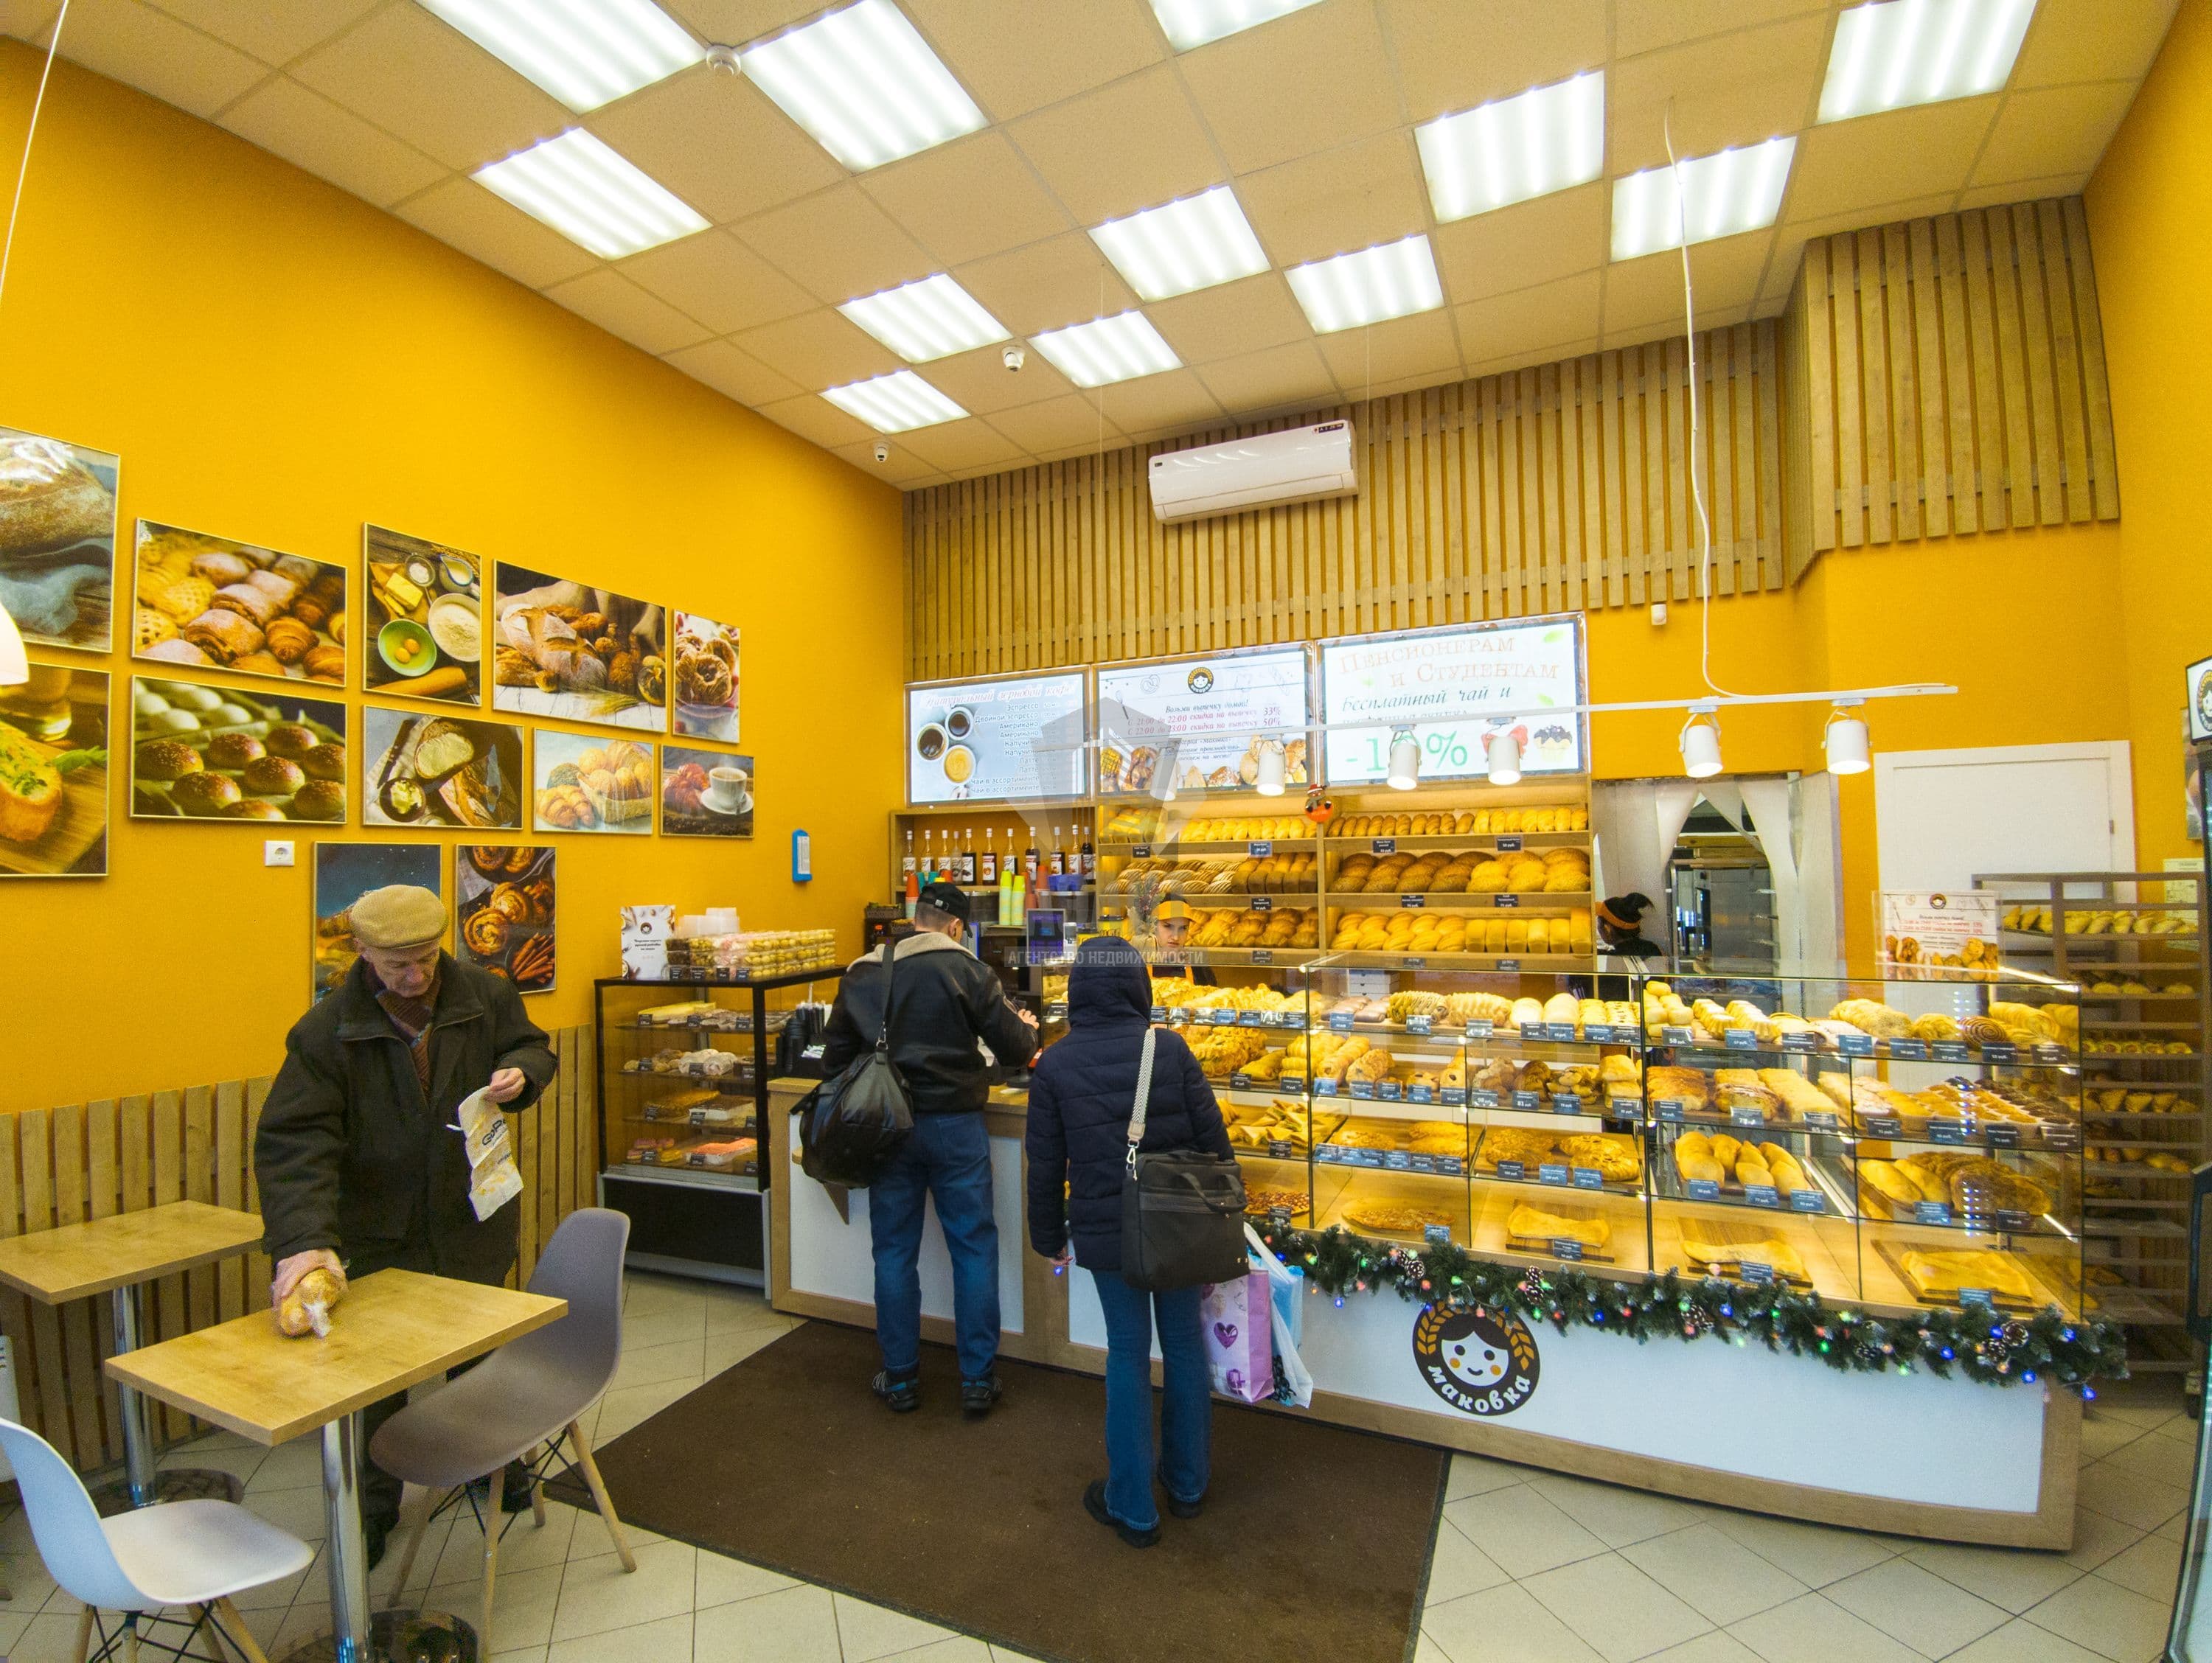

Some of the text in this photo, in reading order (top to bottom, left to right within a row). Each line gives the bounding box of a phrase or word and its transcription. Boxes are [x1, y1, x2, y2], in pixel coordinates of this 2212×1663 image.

[926, 689, 994, 707] Натуральный
[1342, 690, 1447, 713] Бесплатный
[1458, 685, 1489, 701] чай
[1007, 702, 1039, 711] Эспрессо
[1166, 705, 1191, 714] Возьми
[1193, 703, 1221, 712] выпечку
[1168, 715, 1187, 723] 22:00
[1190, 712, 1214, 721] скидка
[1168, 724, 1187, 733] 23:00
[1190, 722, 1214, 731] скидка
[1428, 1365, 1531, 1413] маковка
